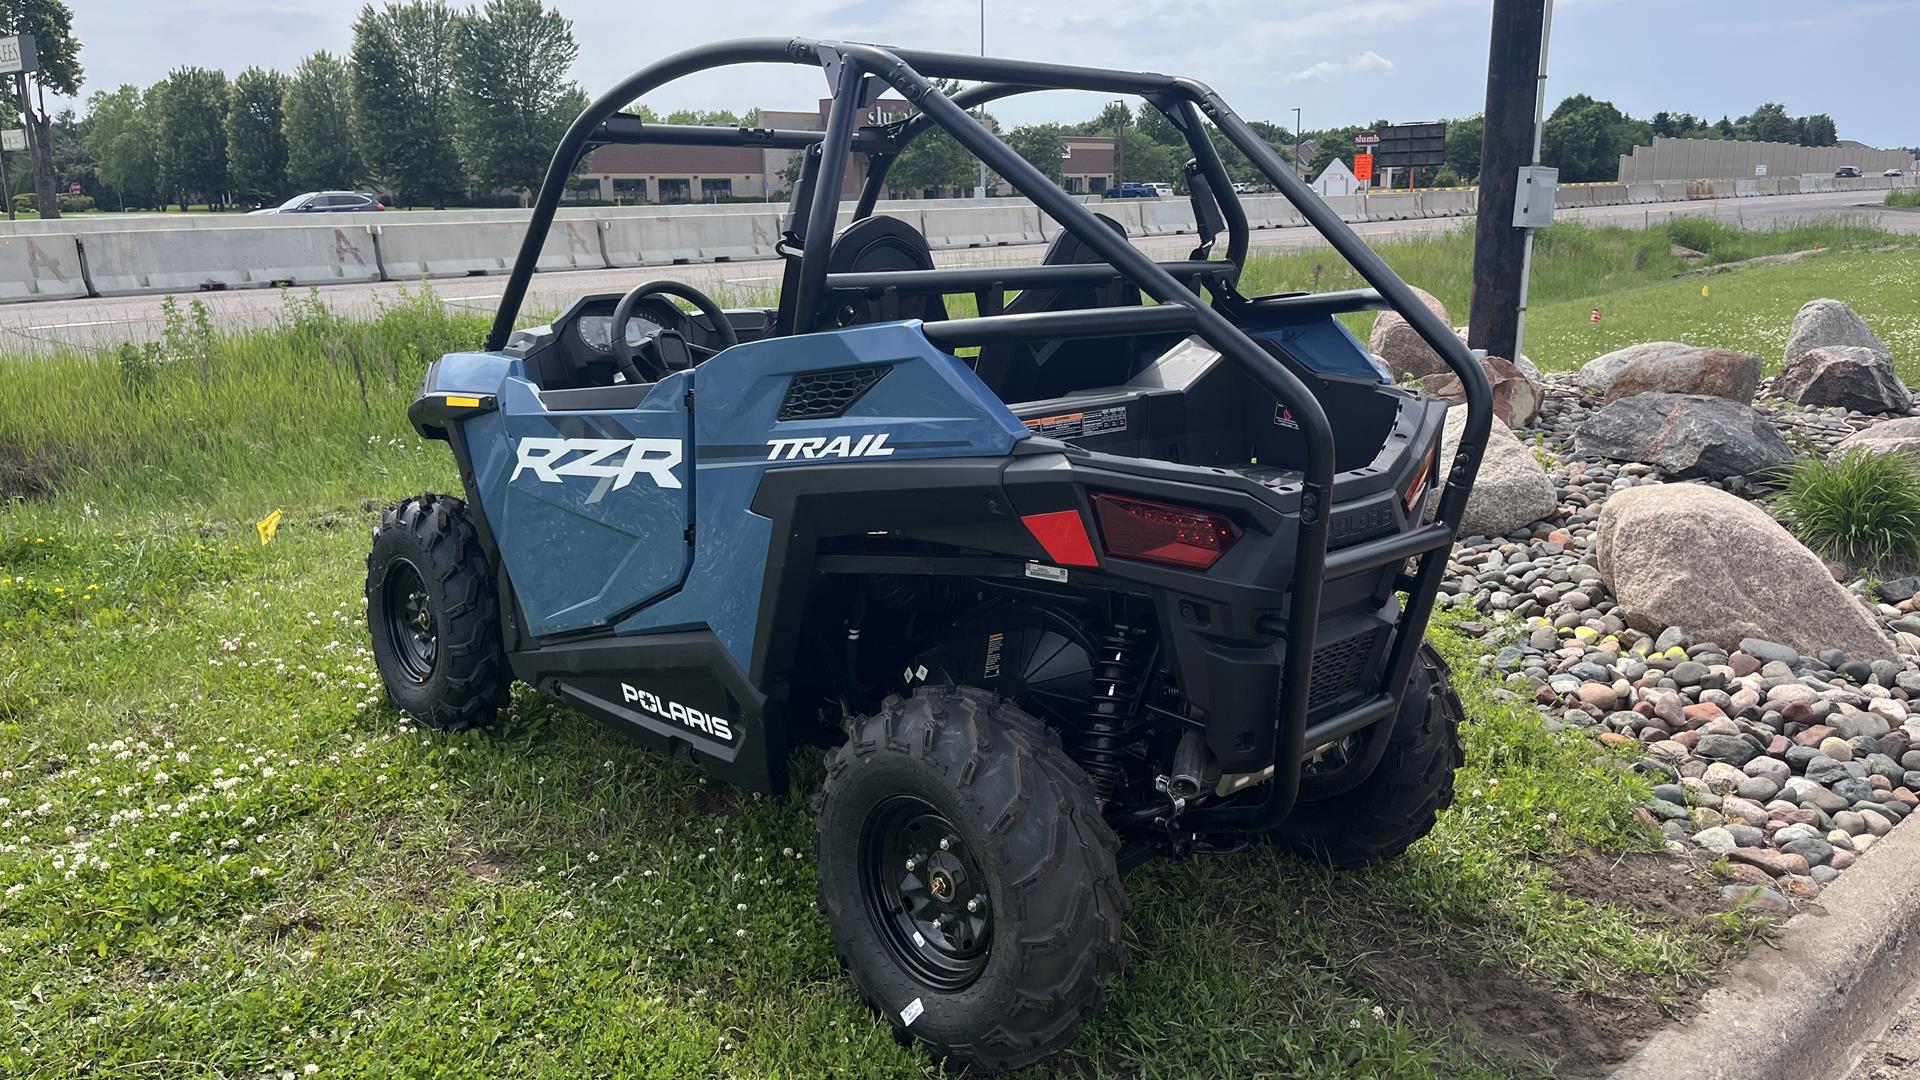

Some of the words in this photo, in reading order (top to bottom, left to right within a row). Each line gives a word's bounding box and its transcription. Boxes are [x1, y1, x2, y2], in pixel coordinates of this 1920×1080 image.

[1355, 134, 1380, 143] slumb
[335, 229, 365, 265] A
[508, 437, 683, 492] RZR
[766, 433, 895, 460] TRAIL
[621, 682, 733, 741] POLARIS
